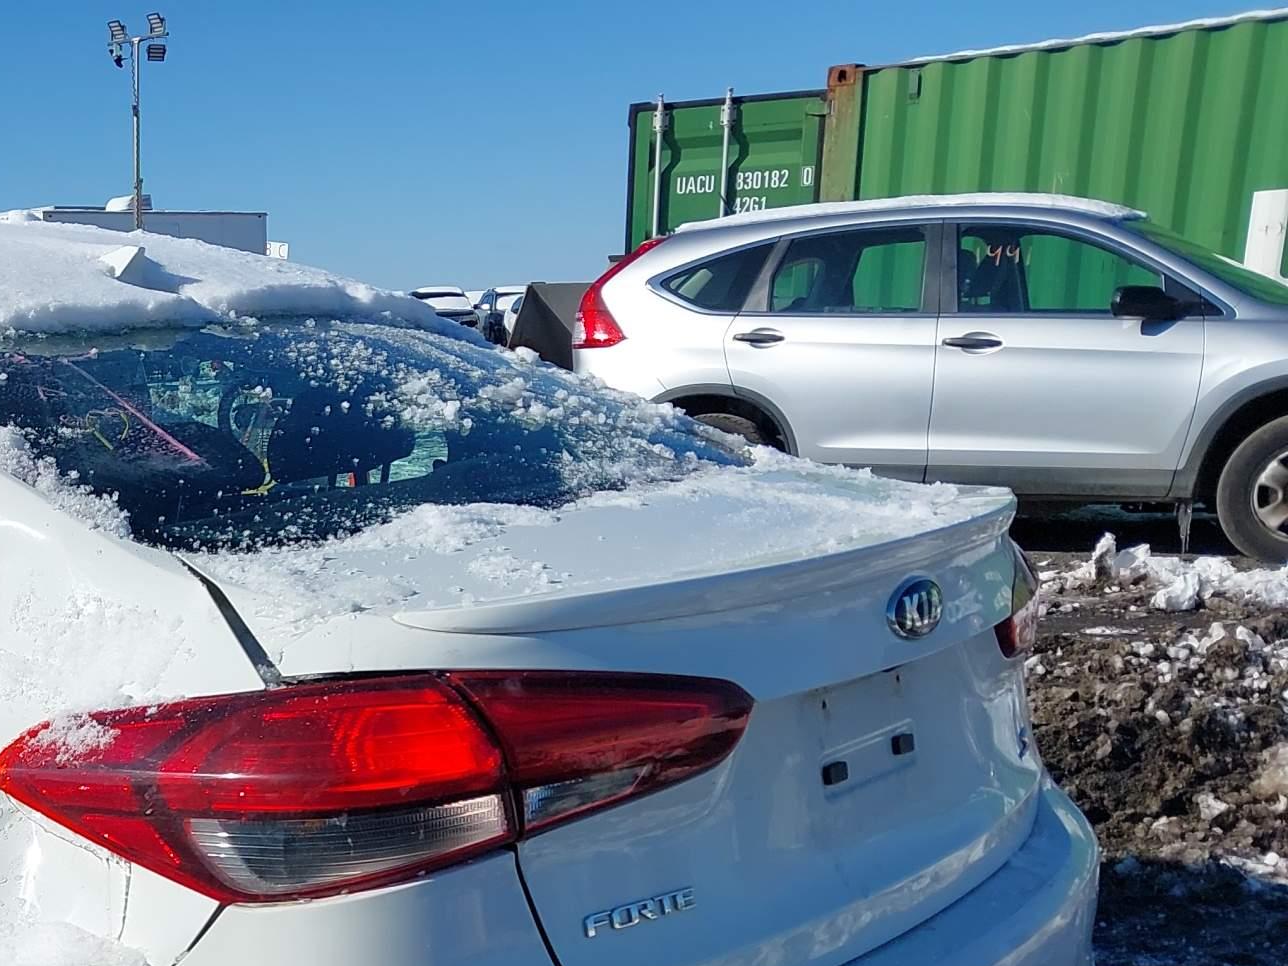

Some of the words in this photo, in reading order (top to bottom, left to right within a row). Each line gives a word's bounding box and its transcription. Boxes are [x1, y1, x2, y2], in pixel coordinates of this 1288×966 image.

[676, 175, 715, 194] UACU
[736, 169, 789, 190] 830182
[803, 167, 812, 185] 0
[902, 590, 941, 629] KIA
[584, 886, 696, 938] FORTE
